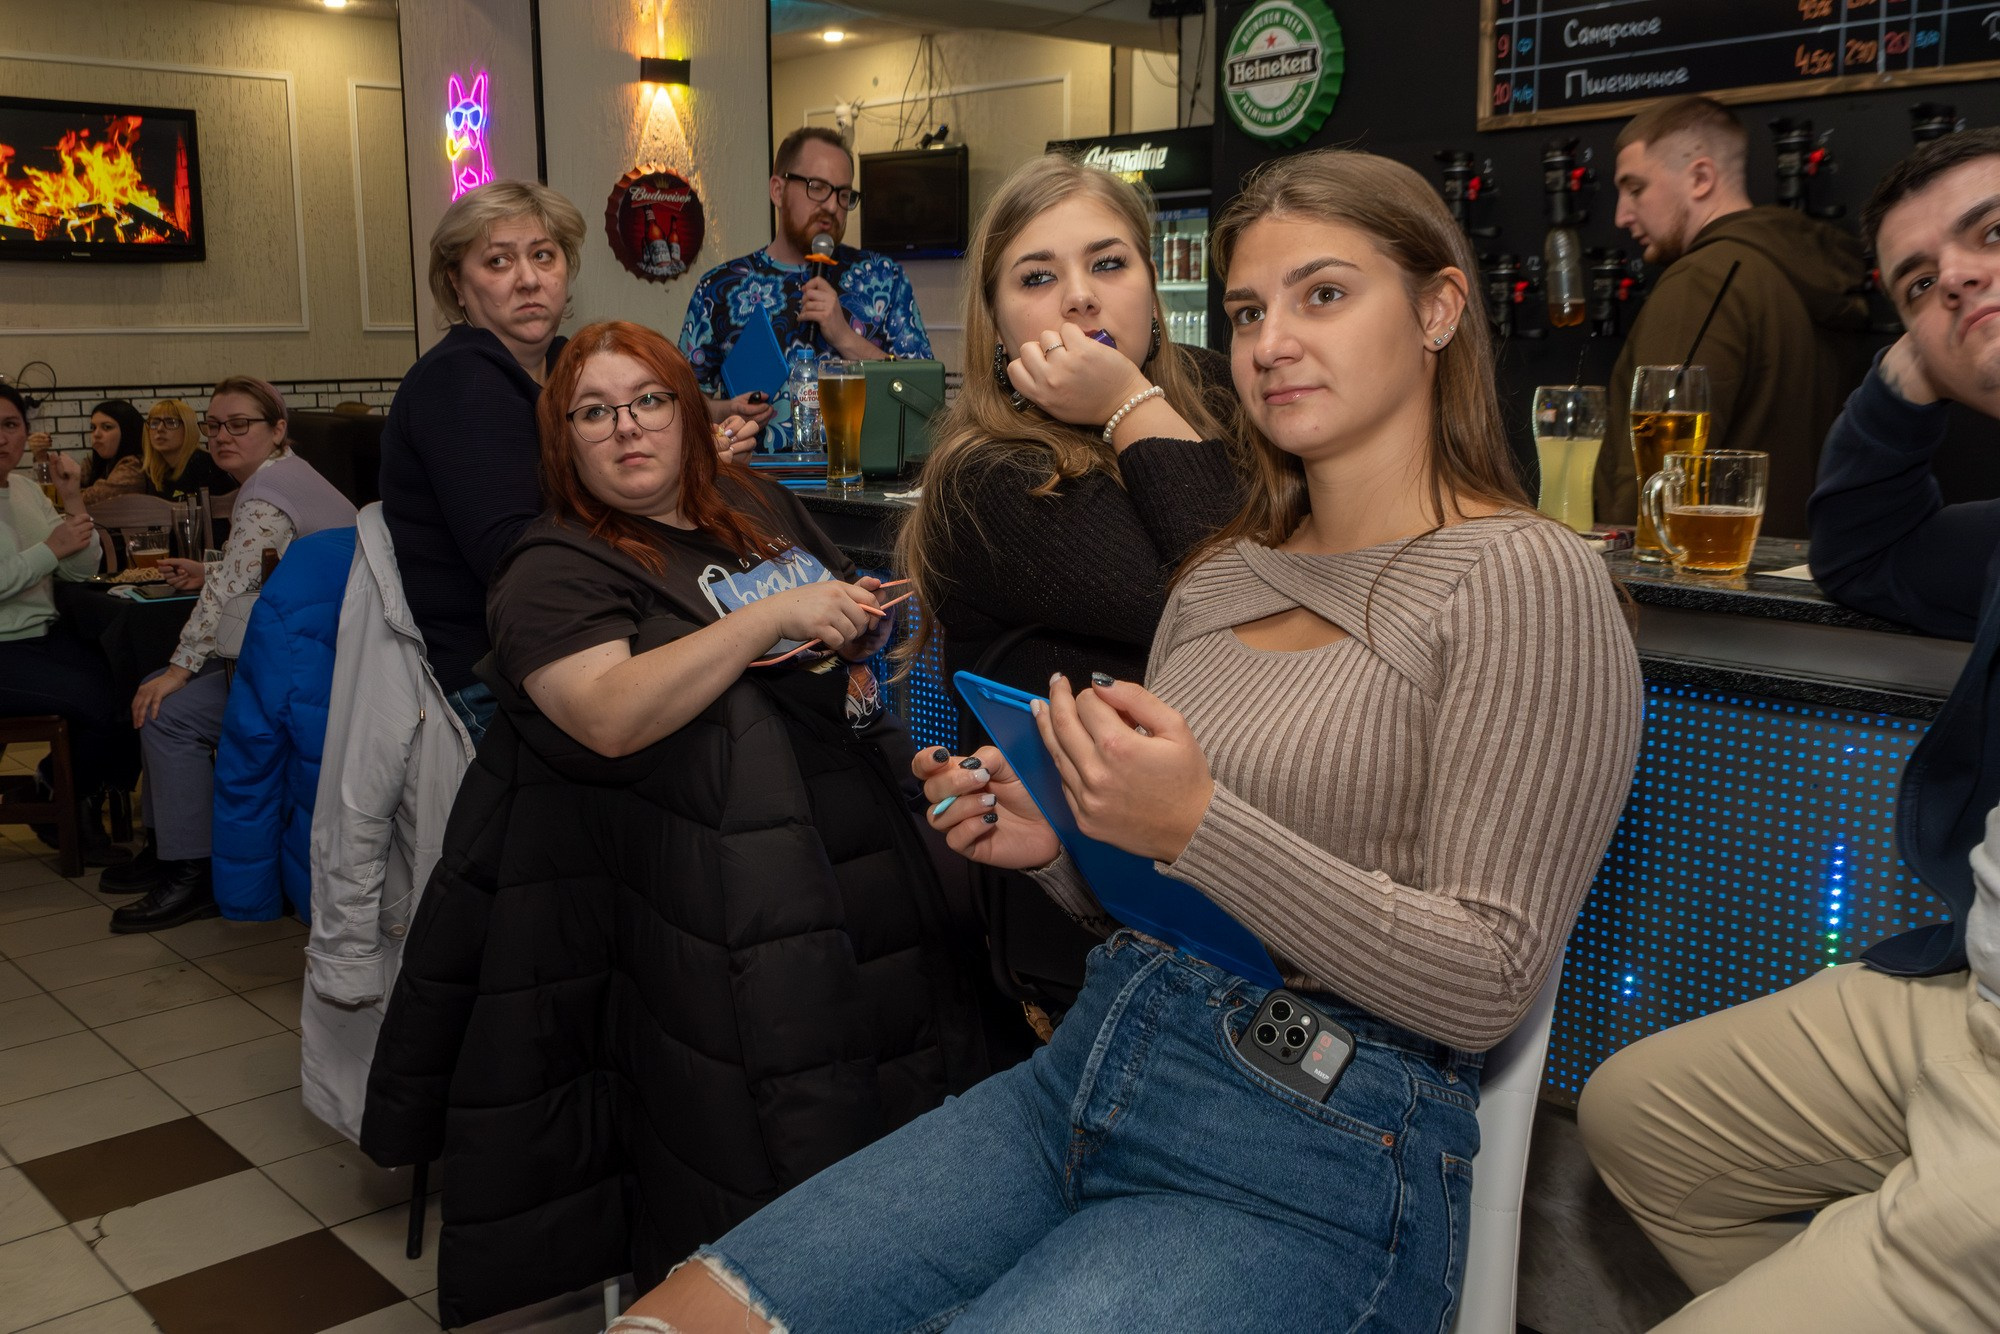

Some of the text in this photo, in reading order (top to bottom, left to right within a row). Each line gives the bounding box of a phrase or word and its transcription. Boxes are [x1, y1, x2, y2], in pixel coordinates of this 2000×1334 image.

[1498, 34, 1511, 58] 9
[1564, 17, 1662, 47] Самарское
[1884, 31, 1910, 54] 20
[1233, 50, 1314, 83] Heineken
[1494, 83, 1511, 106] 10
[1565, 67, 1690, 99] Пшеничное
[1239, 95, 1274, 122] PREMIUM
[1483, 159, 1493, 173] 2
[630, 186, 691, 203] Budweiser
